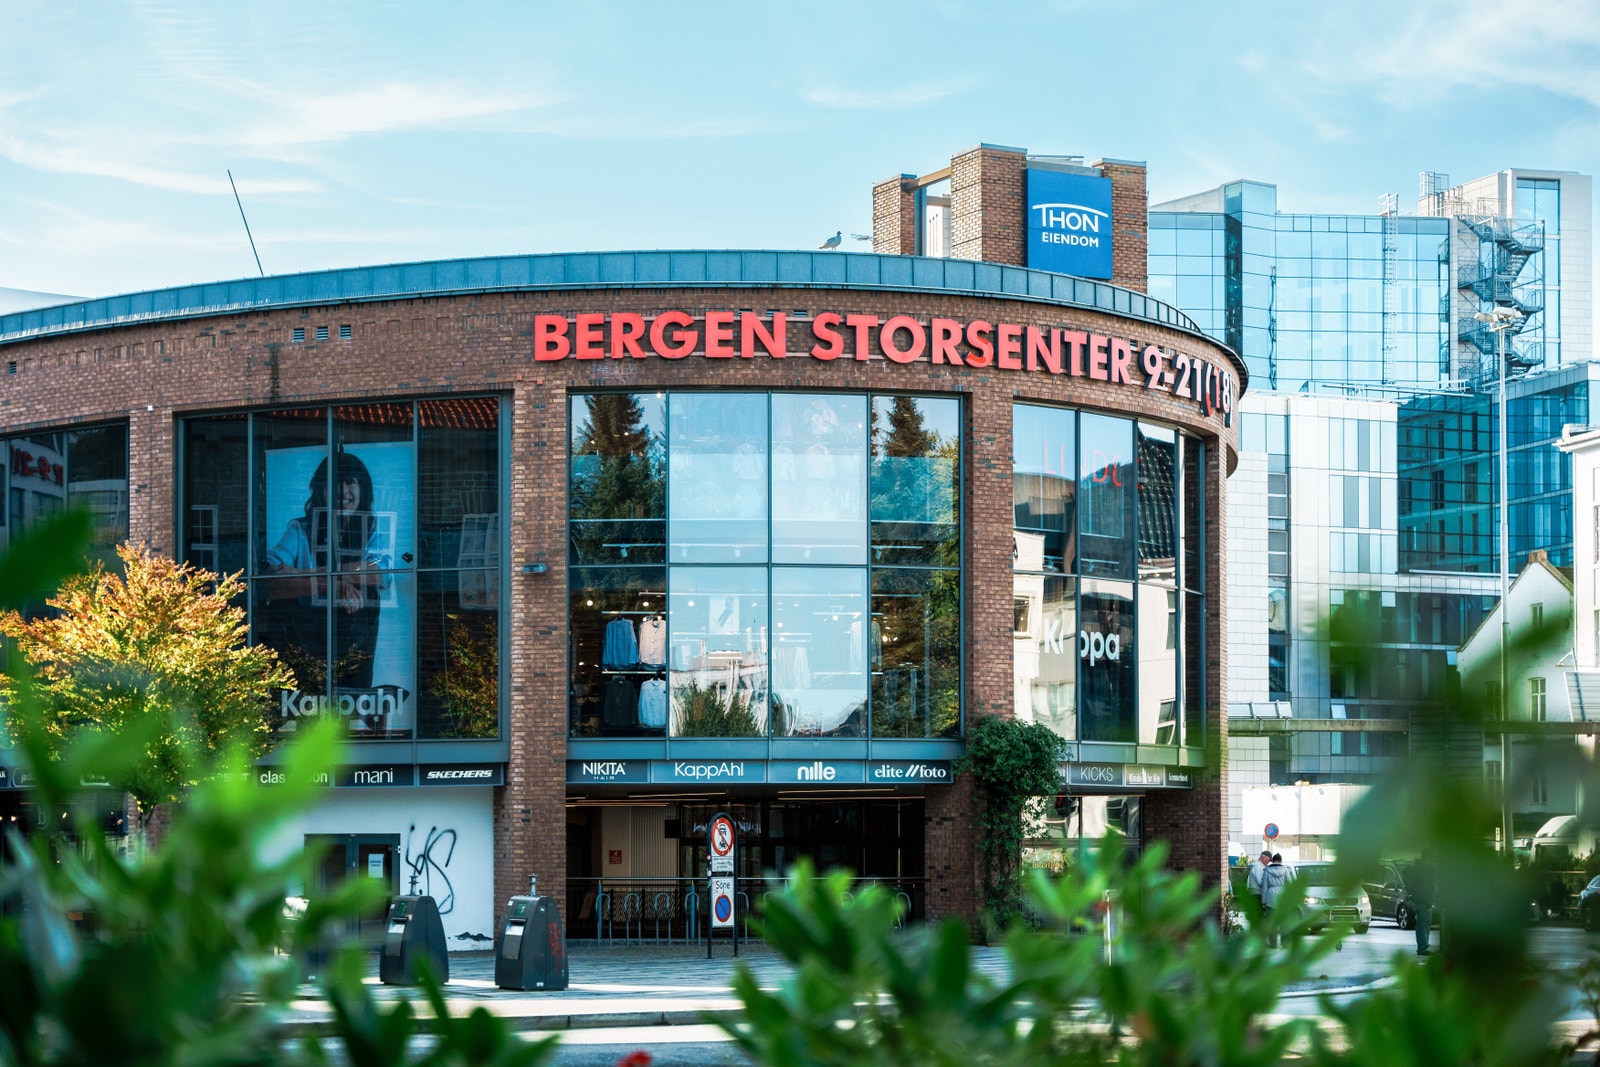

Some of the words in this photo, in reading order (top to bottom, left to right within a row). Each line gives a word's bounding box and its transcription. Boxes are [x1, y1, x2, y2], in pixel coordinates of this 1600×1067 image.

[1032, 203, 1108, 233] THON
[1041, 232, 1099, 248] EIENDOM
[533, 311, 787, 361] BERGEN
[810, 312, 1133, 385] STORSENTER
[354, 767, 393, 783] mani
[426, 769, 493, 780] SKECHERS
[582, 762, 626, 776] NIKITA
[674, 762, 744, 779] KappAhl
[797, 761, 836, 781] nille
[874, 764, 903, 778] elite
[1080, 766, 1114, 782] KICKS
[715, 880, 730, 890] Sone
